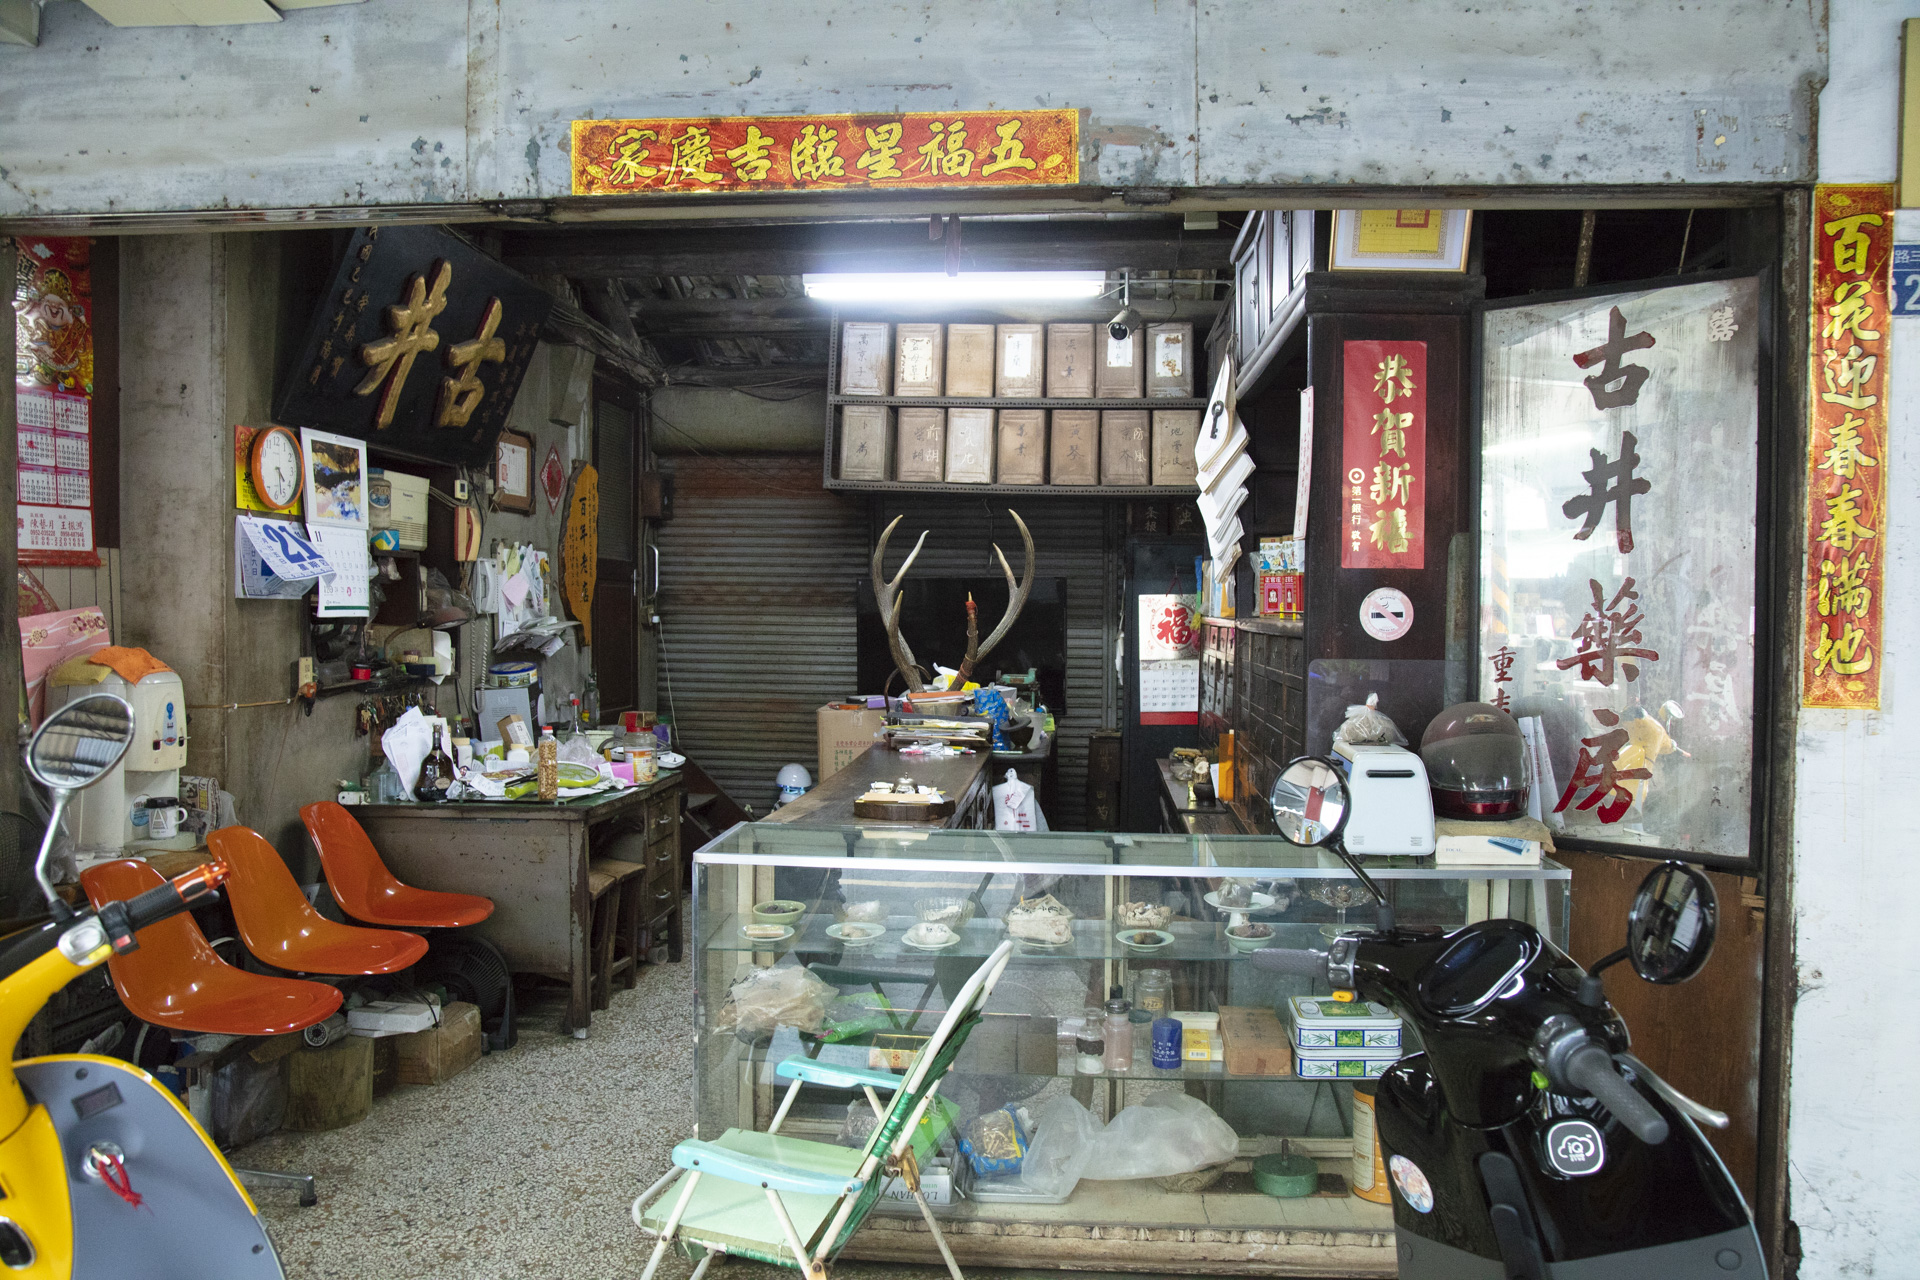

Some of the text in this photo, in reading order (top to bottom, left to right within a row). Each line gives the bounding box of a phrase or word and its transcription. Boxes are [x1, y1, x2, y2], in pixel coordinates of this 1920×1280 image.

[353, 259, 507, 430] 古井
[1370, 353, 1418, 553] 恭賀新禧
[1351, 486, 1362, 525] 第一銀行
[262, 523, 325, 564] 21
[1157, 607, 1192, 645] 福
